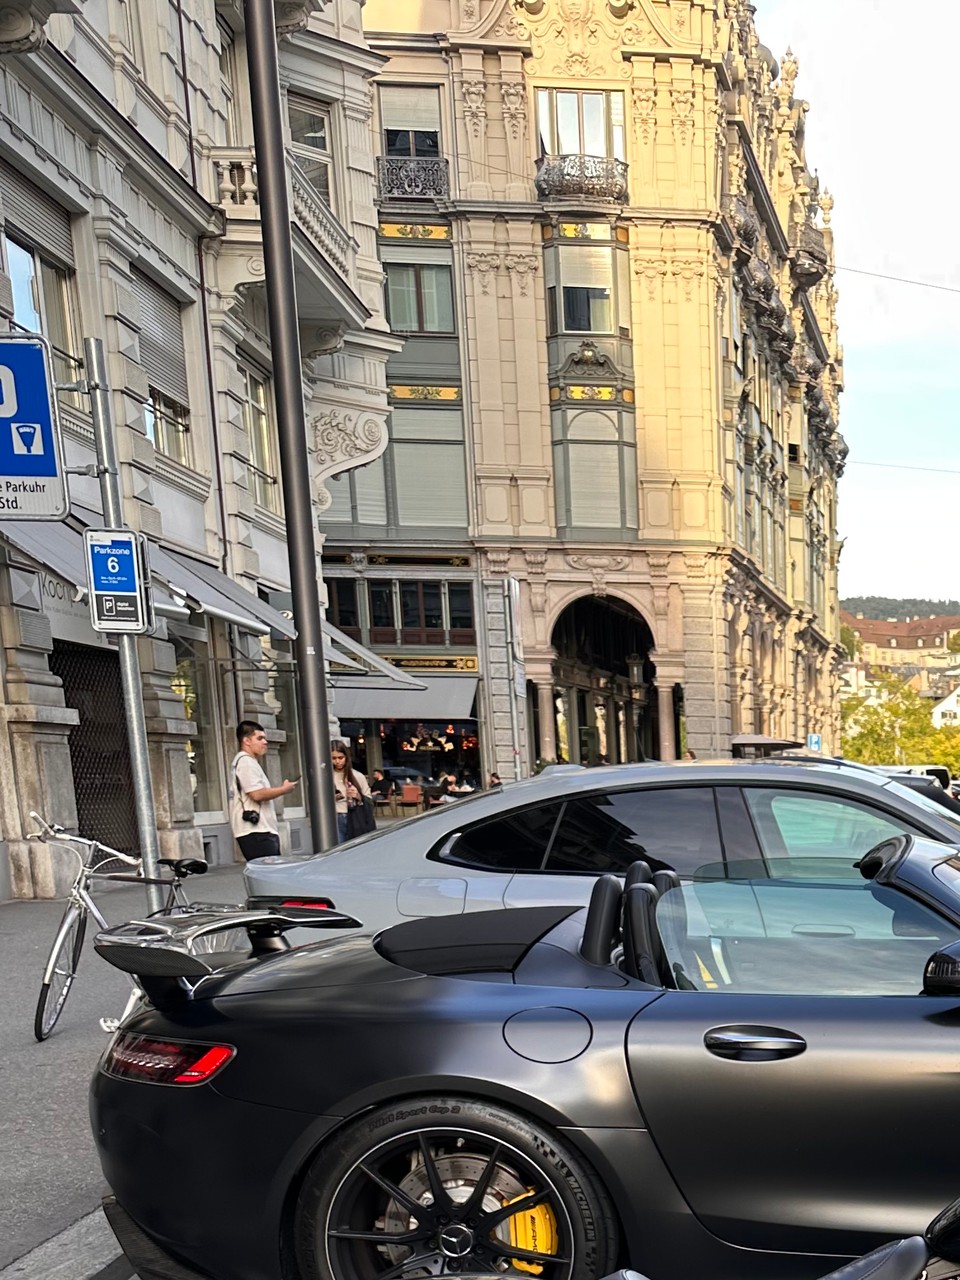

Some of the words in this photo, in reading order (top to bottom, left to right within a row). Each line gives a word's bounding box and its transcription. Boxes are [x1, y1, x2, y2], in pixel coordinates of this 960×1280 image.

[6, 481, 46, 493] Parkuhr
[0, 496, 22, 509] Std.
[94, 546, 130, 556] Parkzone
[107, 556, 119, 573] 6
[106, 601, 112, 609] P
[368, 1114, 394, 1132] Pilot
[395, 1106, 428, 1121] Sport
[429, 1105, 449, 1114] Cup
[450, 1106, 461, 1114] 2
[566, 1176, 597, 1242] MICHELIN
